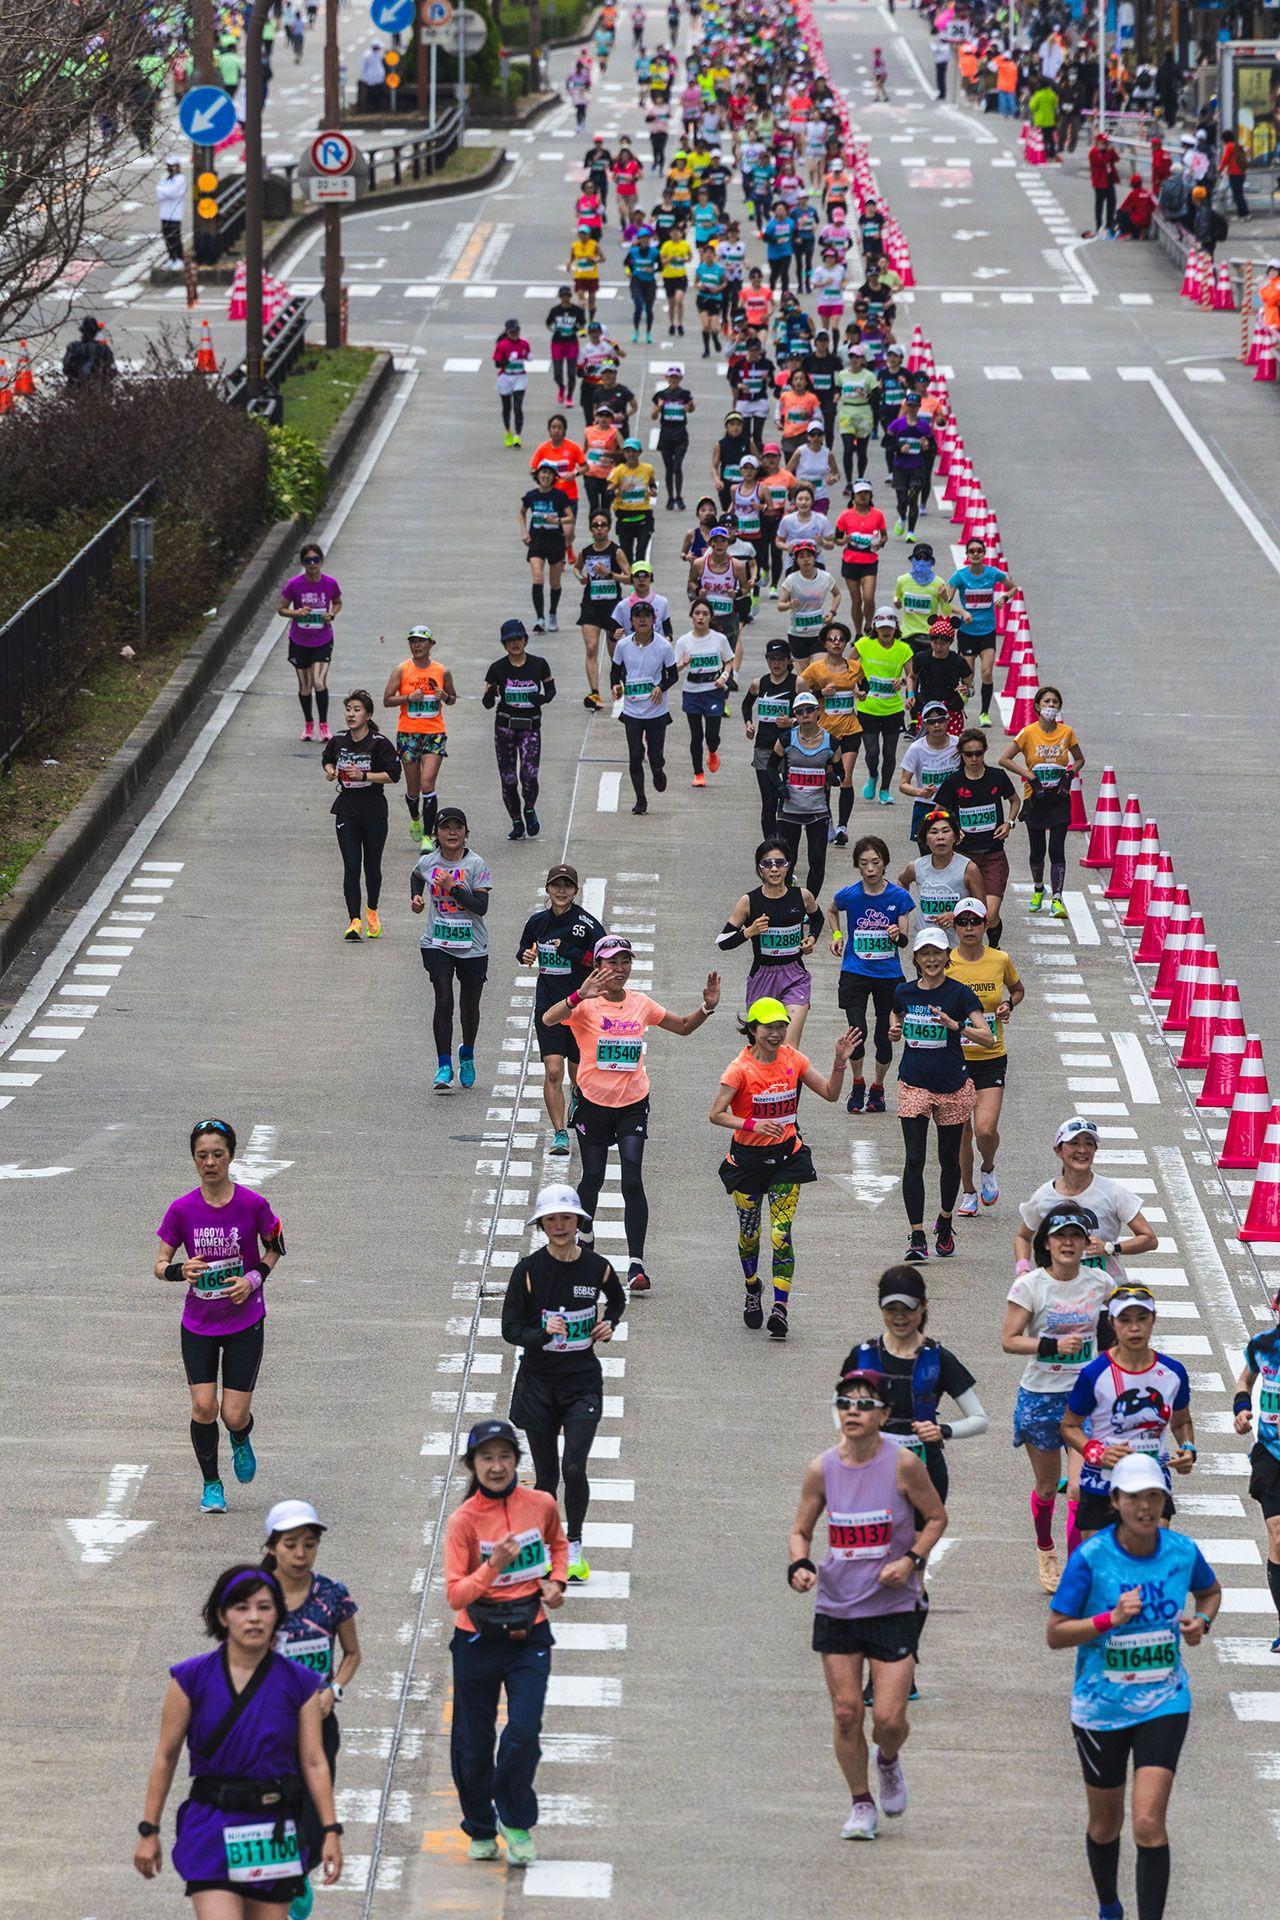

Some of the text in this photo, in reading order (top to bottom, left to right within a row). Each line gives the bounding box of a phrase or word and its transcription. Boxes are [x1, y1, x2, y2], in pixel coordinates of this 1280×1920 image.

[960, 811, 996, 826] C12298
[434, 925, 471, 940] D13454
[572, 924, 586, 938] 55
[761, 935, 800, 948] C12886
[857, 937, 892, 950] D13435
[903, 1023, 945, 1039] E14637
[598, 1045, 641, 1062] E15406
[753, 1099, 796, 1117] D13123
[193, 1227, 225, 1238] NAGOYA
[194, 1237, 231, 1248] WOMEN'S
[194, 1247, 238, 1257] MARATHON
[829, 1522, 890, 1545] D13137
[1106, 1643, 1176, 1669] G16446
